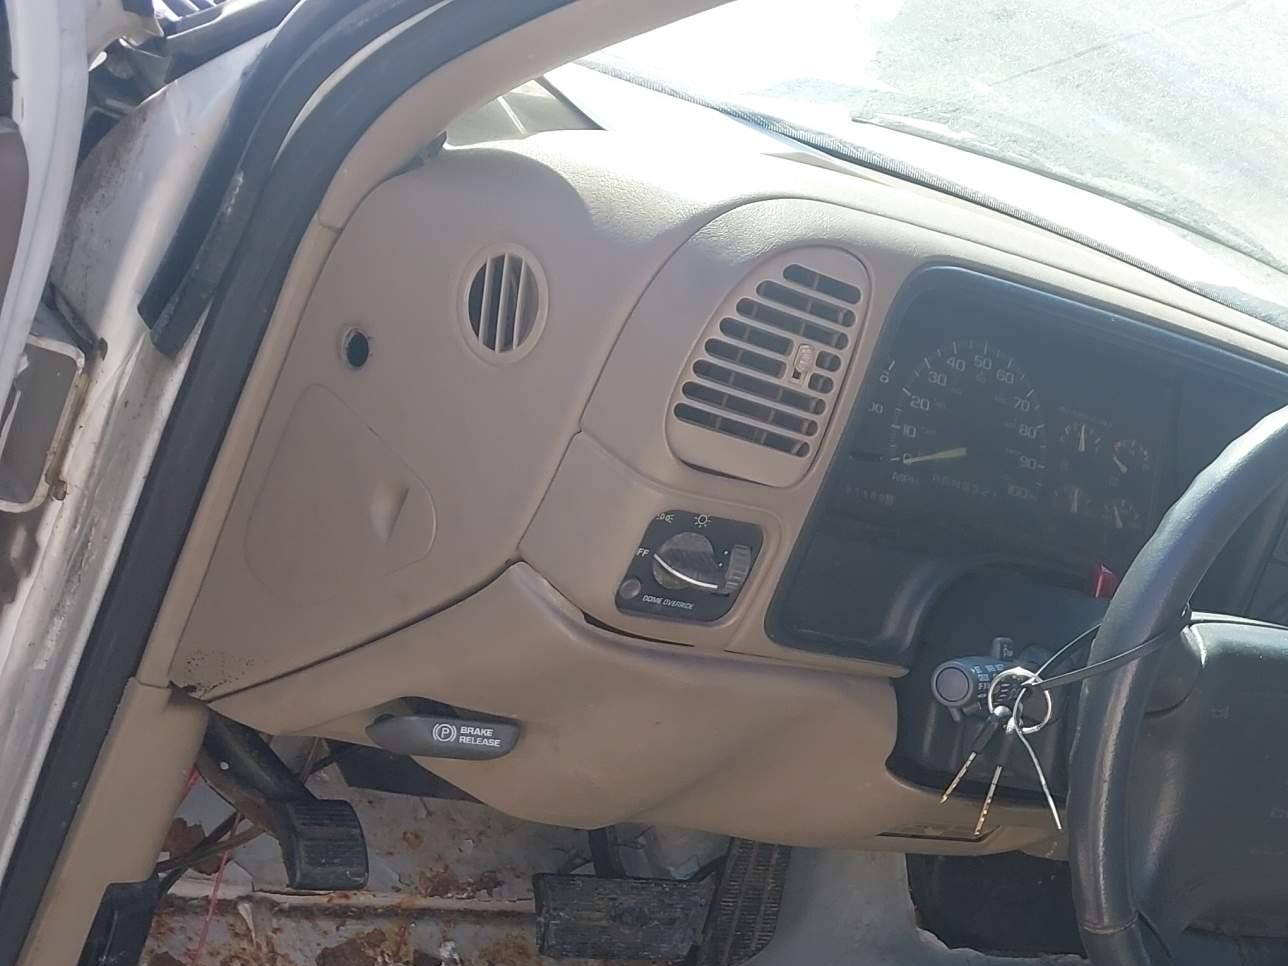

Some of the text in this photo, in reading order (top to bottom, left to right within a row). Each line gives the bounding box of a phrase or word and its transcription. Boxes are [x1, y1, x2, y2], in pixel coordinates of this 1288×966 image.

[946, 356, 967, 373] 40
[974, 354, 993, 370] 50
[928, 370, 948, 387] 30
[996, 369, 1015, 385] 60
[910, 395, 931, 411] 20
[1014, 397, 1031, 412] 70
[903, 424, 917, 438] 10
[1018, 424, 1037, 439] 80
[460, 726, 493, 737] BRAKE
[459, 736, 501, 747] RELEASE
